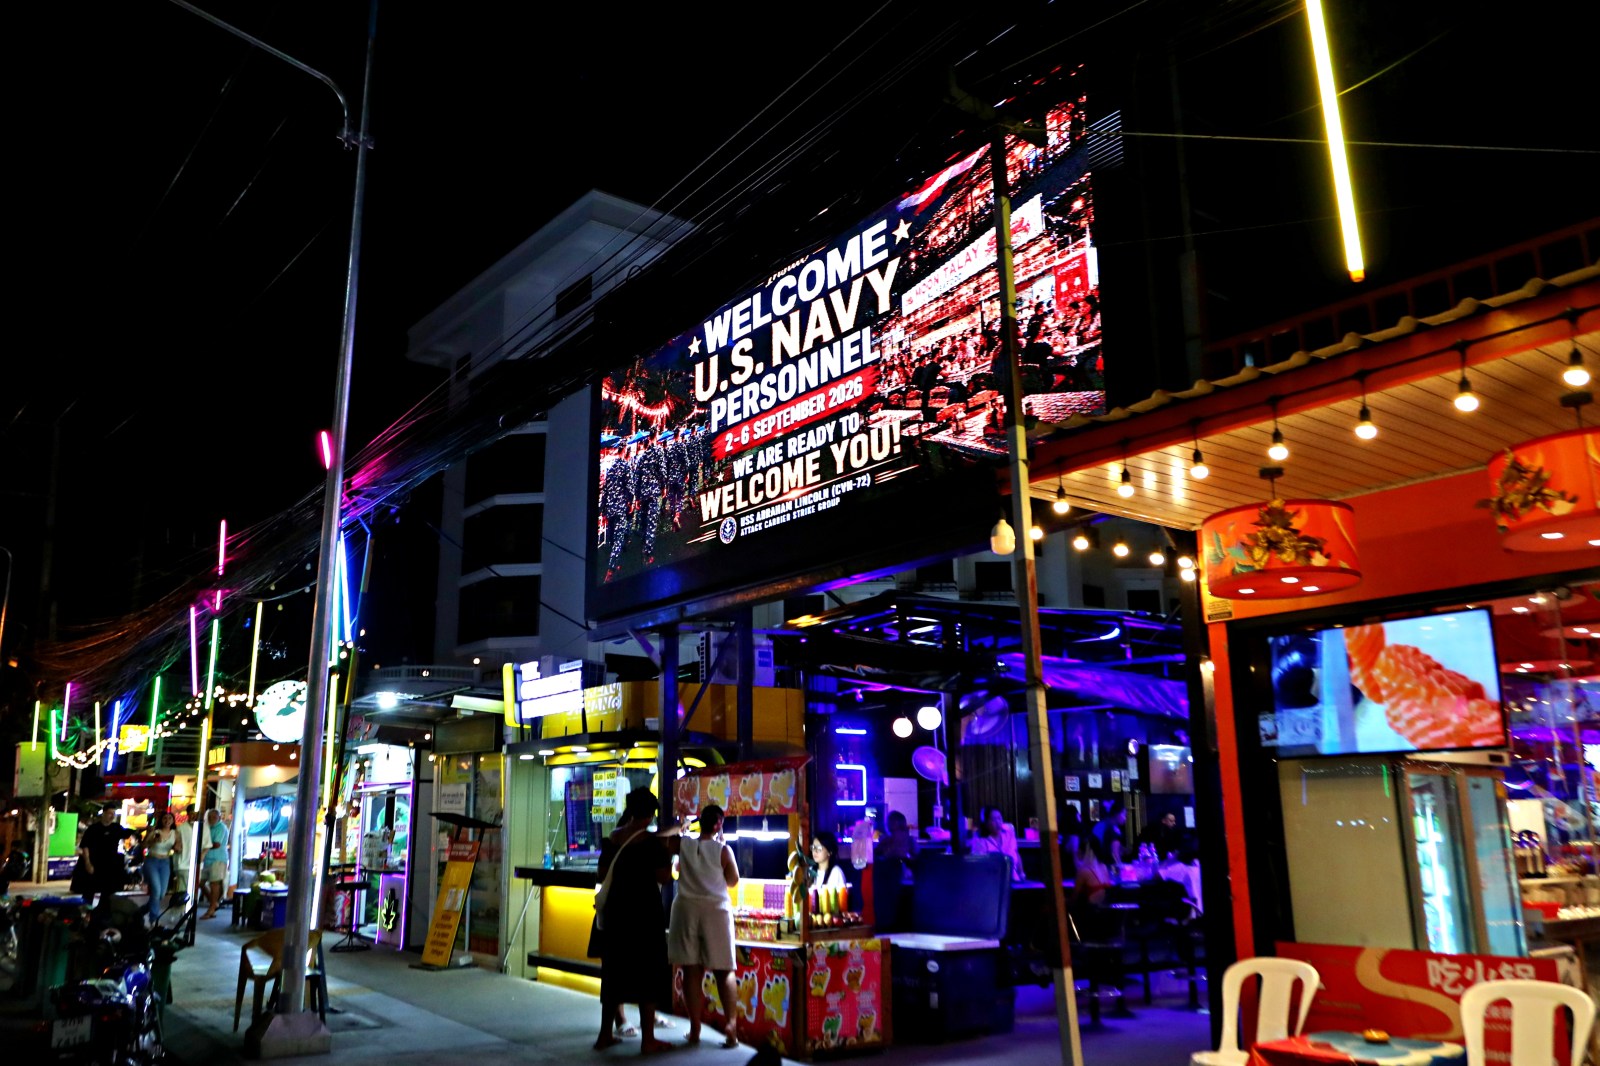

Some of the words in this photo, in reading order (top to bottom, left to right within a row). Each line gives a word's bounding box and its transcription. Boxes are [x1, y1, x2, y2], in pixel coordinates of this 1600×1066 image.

[704, 219, 889, 354] WELCOME
[943, 243, 979, 278] TALAY
[694, 338, 764, 401] U.S.
[772, 257, 901, 367] NAVY
[711, 326, 881, 433] PERSONNEL
[725, 426, 750, 452] 2-6
[753, 393, 826, 440] SEPTEMBER
[828, 376, 863, 408] 2026
[700, 450, 821, 522] WELCOME
[830, 422, 901, 475] YOU!
[733, 456, 754, 479] WE
[756, 445, 784, 471] ARE
[787, 421, 837, 457] READY
[839, 412, 860, 434] TO
[740, 513, 755, 527] USS
[756, 501, 793, 521] ABRAHAM
[794, 488, 830, 509] LINCOLN
[740, 522, 763, 536] ATTACK
[764, 513, 791, 528] CARRIER
[792, 505, 816, 519] STRIKE
[817, 496, 841, 511] GROUP
